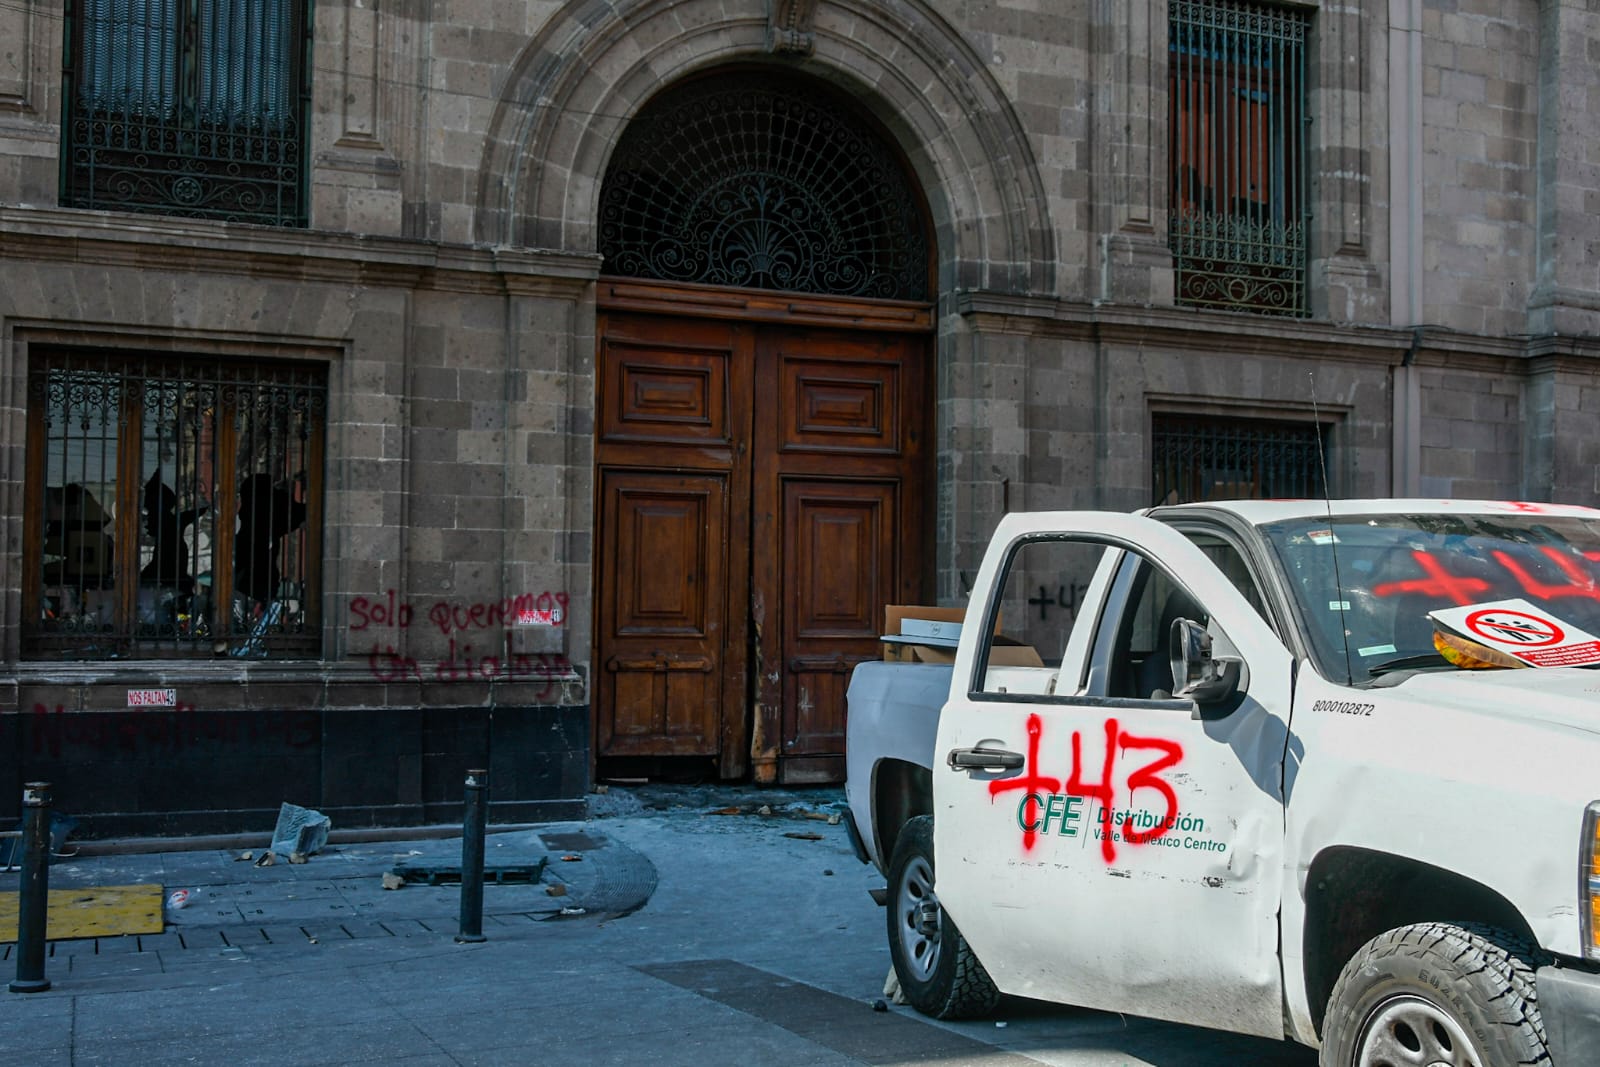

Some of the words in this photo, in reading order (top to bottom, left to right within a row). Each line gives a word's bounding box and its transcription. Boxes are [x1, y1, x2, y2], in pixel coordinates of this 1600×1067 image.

[1372, 546, 1600, 606] +4
[349, 588, 414, 631] Solo
[128, 691, 142, 705] NOS
[144, 691, 166, 705] FALTAN
[1312, 699, 1376, 717] 8000102872
[1016, 791, 1085, 838] CFE
[1096, 806, 1205, 833] Distribución
[1094, 828, 1121, 842] Valle
[1184, 836, 1227, 853] Centro
